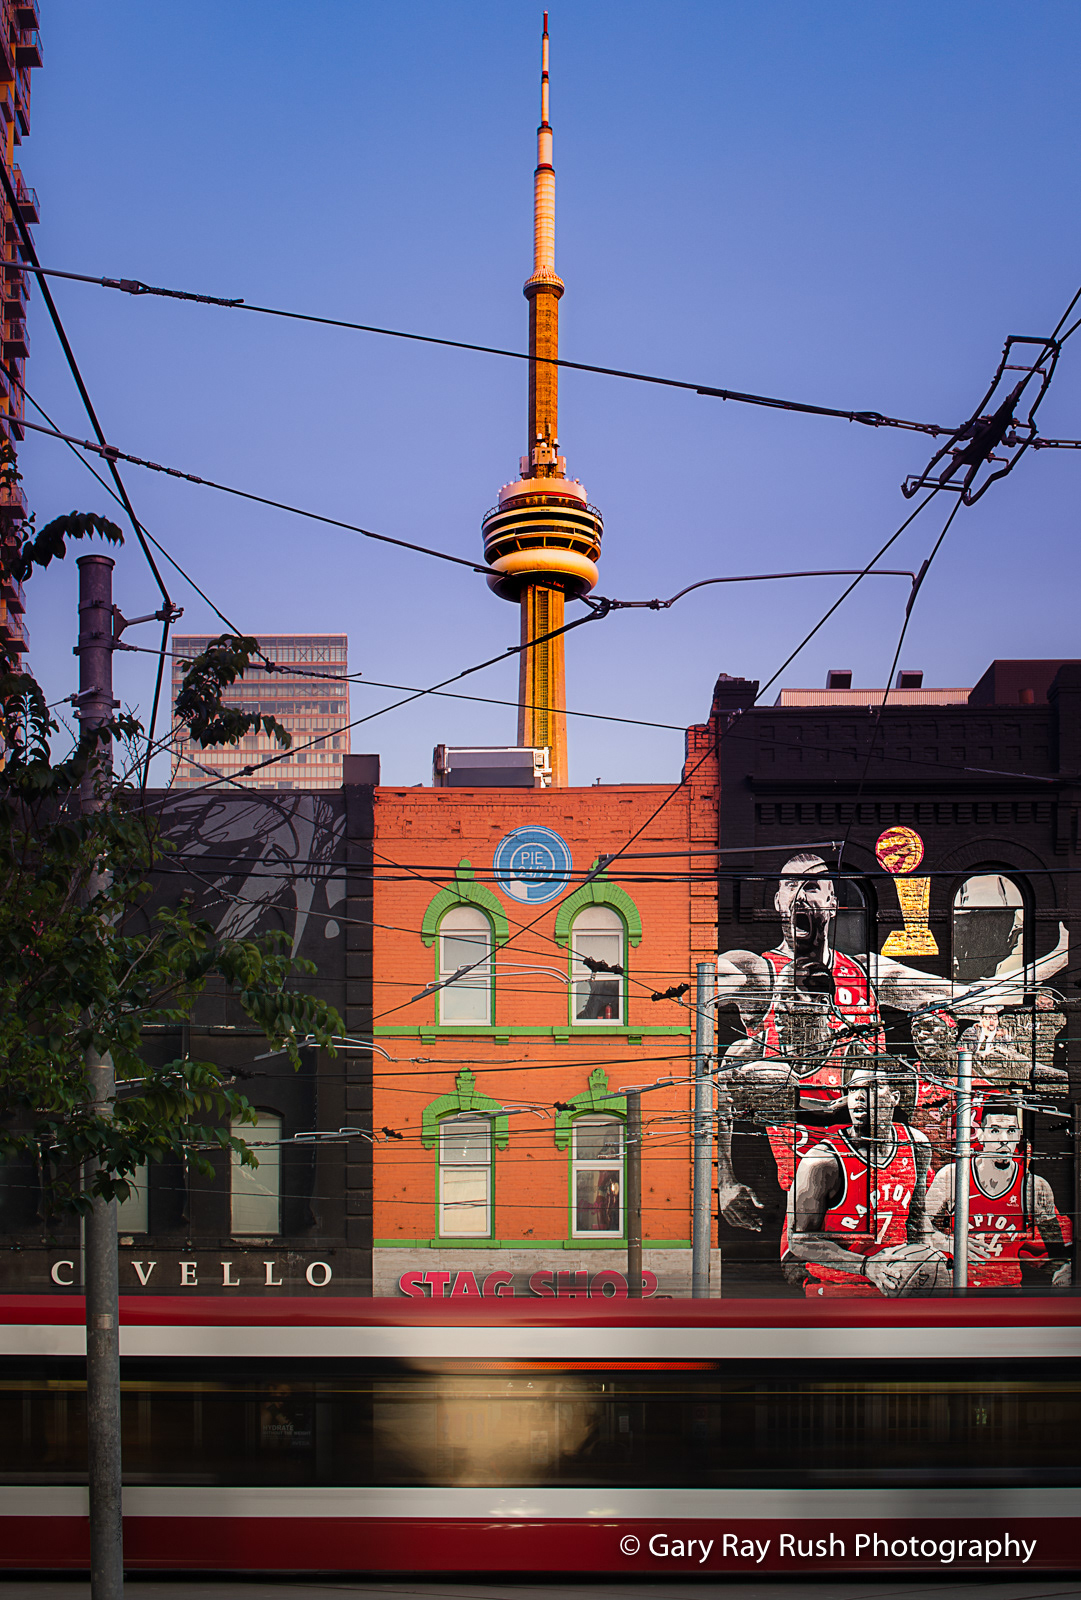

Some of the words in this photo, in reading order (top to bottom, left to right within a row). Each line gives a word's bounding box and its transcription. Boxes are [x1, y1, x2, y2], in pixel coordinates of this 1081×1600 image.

[521, 851, 544, 865] PIE
[518, 866, 546, 878] 24/7
[873, 1211, 893, 1244] 7
[51, 1260, 332, 1287] CVELLO
[399, 1270, 515, 1298] STAG
[529, 1270, 658, 1298] SHOP
